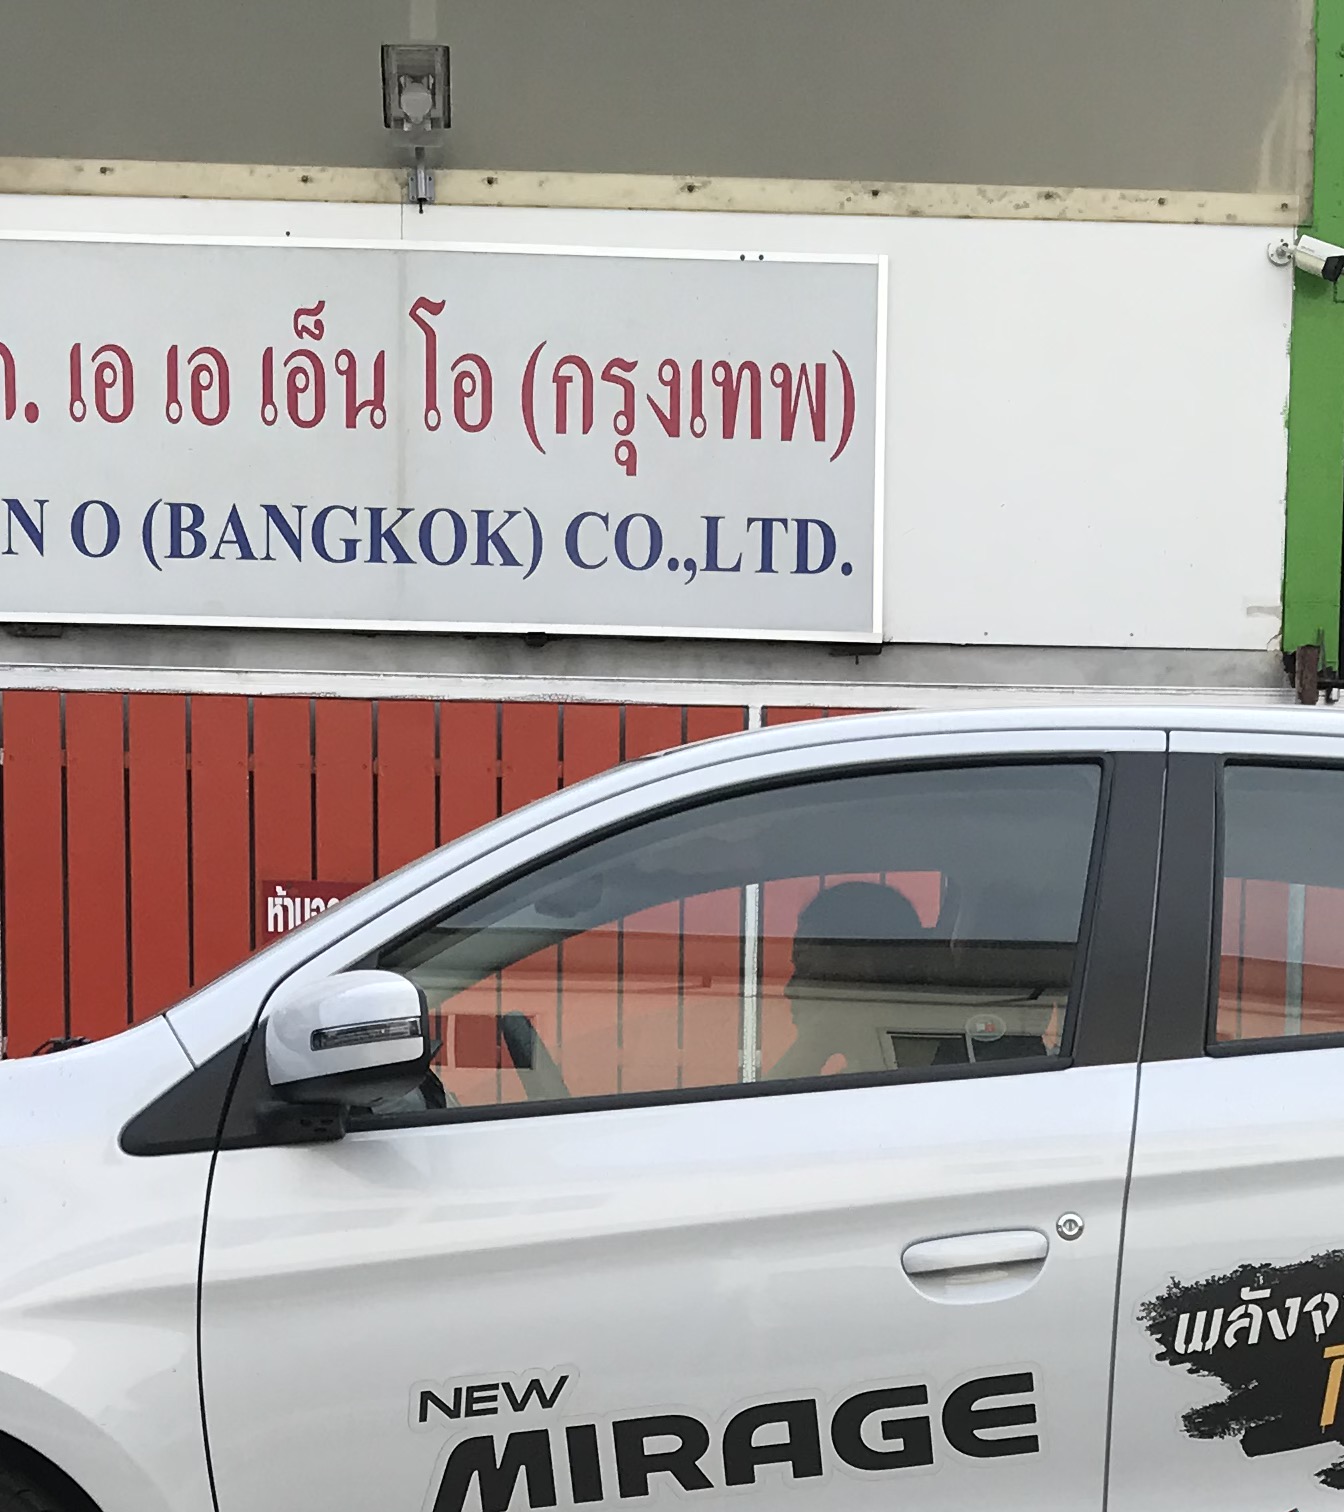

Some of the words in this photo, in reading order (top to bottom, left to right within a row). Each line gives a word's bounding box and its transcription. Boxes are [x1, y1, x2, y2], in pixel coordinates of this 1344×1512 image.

[69, 343, 134, 424] เอ
[166, 345, 230, 426] เอ
[261, 300, 386, 430] เอ็น
[409, 296, 493, 433] โอ
[521, 340, 857, 476] (กรุงเทพ)
[418, 1374, 570, 1423] NEW
